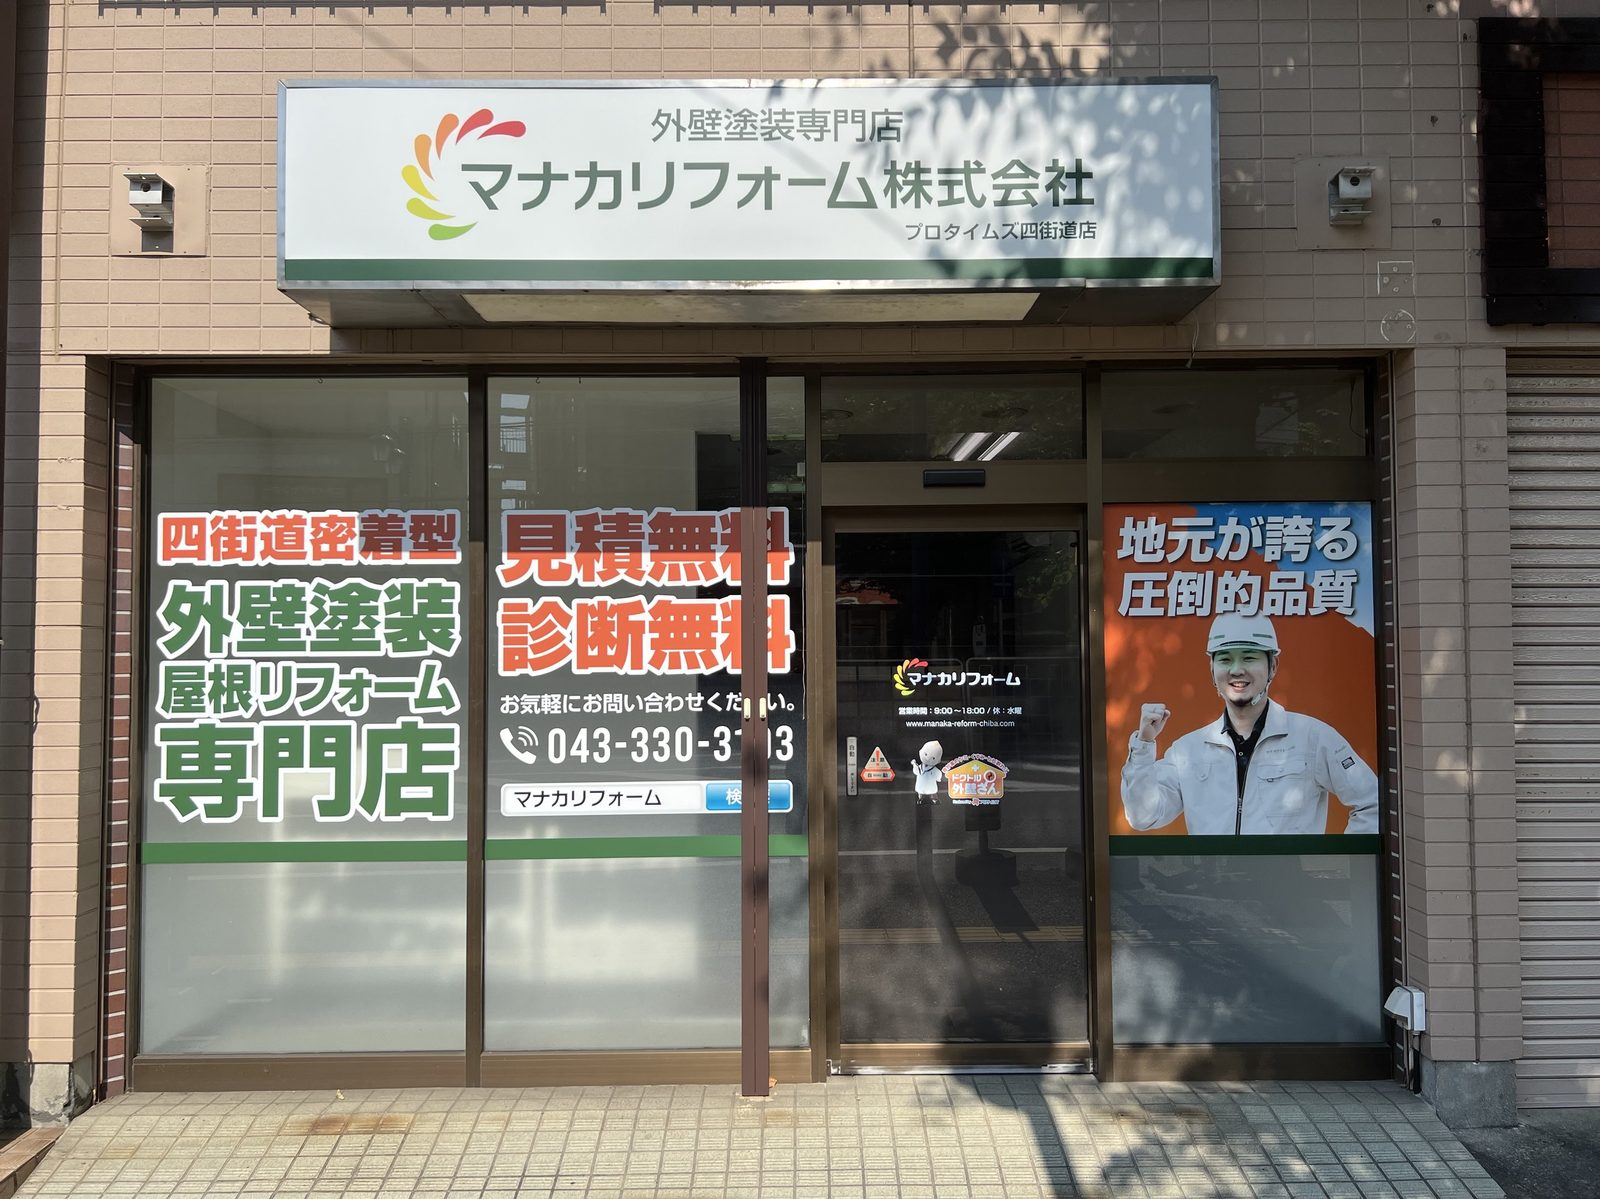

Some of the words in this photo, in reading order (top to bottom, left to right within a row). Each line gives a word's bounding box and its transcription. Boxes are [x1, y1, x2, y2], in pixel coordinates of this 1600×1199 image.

[650, 107, 904, 144] 外壁塗装専門店
[460, 157, 1096, 212] マナカリフォーム株式会社
[905, 219, 1098, 242] プロタイムズ四街道店
[158, 510, 460, 565] 四街道密着型
[1116, 514, 1358, 563] 地元が誇る
[1117, 569, 1357, 617] 圧倒的品質
[157, 579, 460, 657] 外壁塗装
[157, 661, 460, 717] 屋根リフォーム
[907, 672, 1021, 687] マナカリフォーム
[499, 692, 796, 715] お気軽にお問い合わせくだい。
[905, 720, 1015, 728] www.manaka-reform-chiba.com
[547, 725, 794, 764] 043-330-33
[156, 718, 459, 822] 専門店
[513, 789, 662, 809] マナカリフォーム
